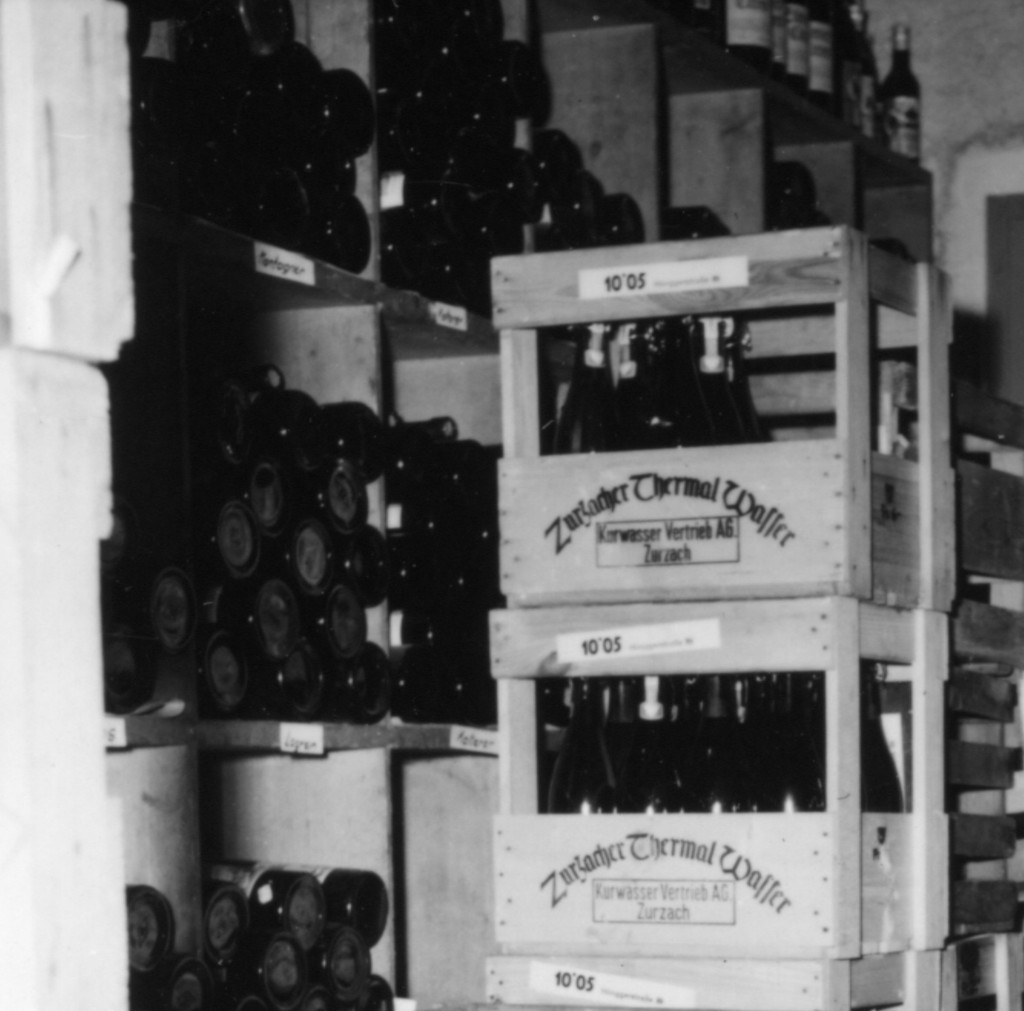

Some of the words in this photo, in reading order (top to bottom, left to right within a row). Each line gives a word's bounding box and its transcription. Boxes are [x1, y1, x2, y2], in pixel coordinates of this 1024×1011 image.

[629, 472, 721, 502] Thermal
[664, 520, 713, 541] Vertrieb
[643, 544, 692, 564] Zurzach
[625, 832, 717, 866] Thermal
[595, 883, 659, 902] Kurwasser
[660, 883, 709, 902] Vertrieb
[636, 902, 691, 921] Zurzach
